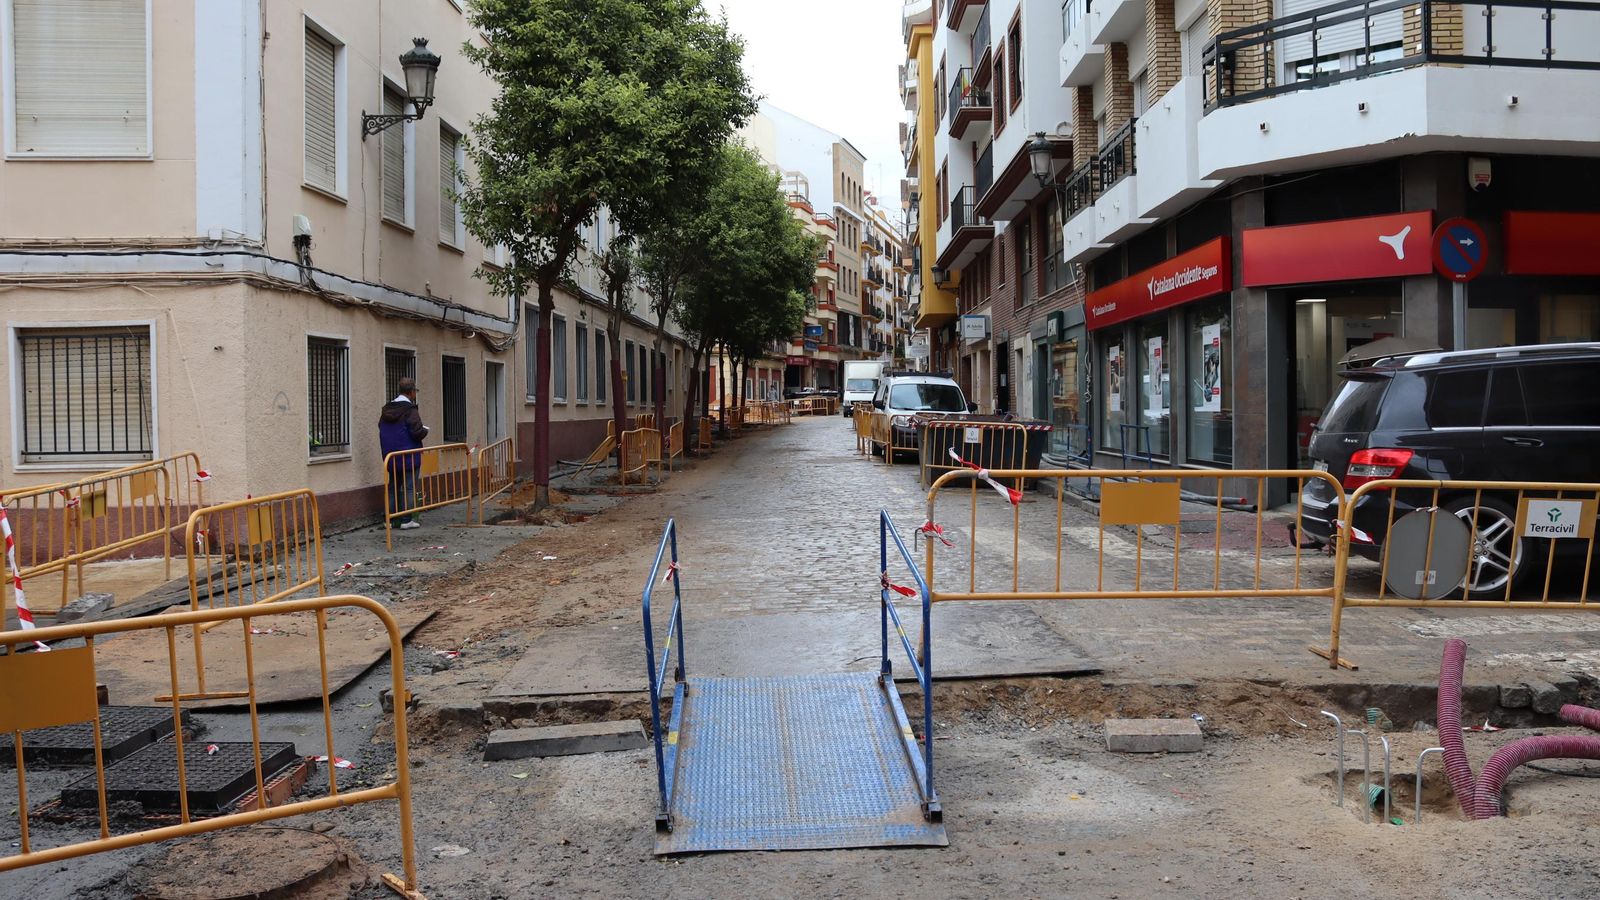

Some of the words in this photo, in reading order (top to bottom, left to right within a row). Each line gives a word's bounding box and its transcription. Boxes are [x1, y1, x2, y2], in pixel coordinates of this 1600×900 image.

[1153, 275, 1175, 296] Catalana
[1174, 265, 1202, 288] Occidente
[1201, 265, 1218, 281] Seguros
[1530, 523, 1575, 533] Terracivil
